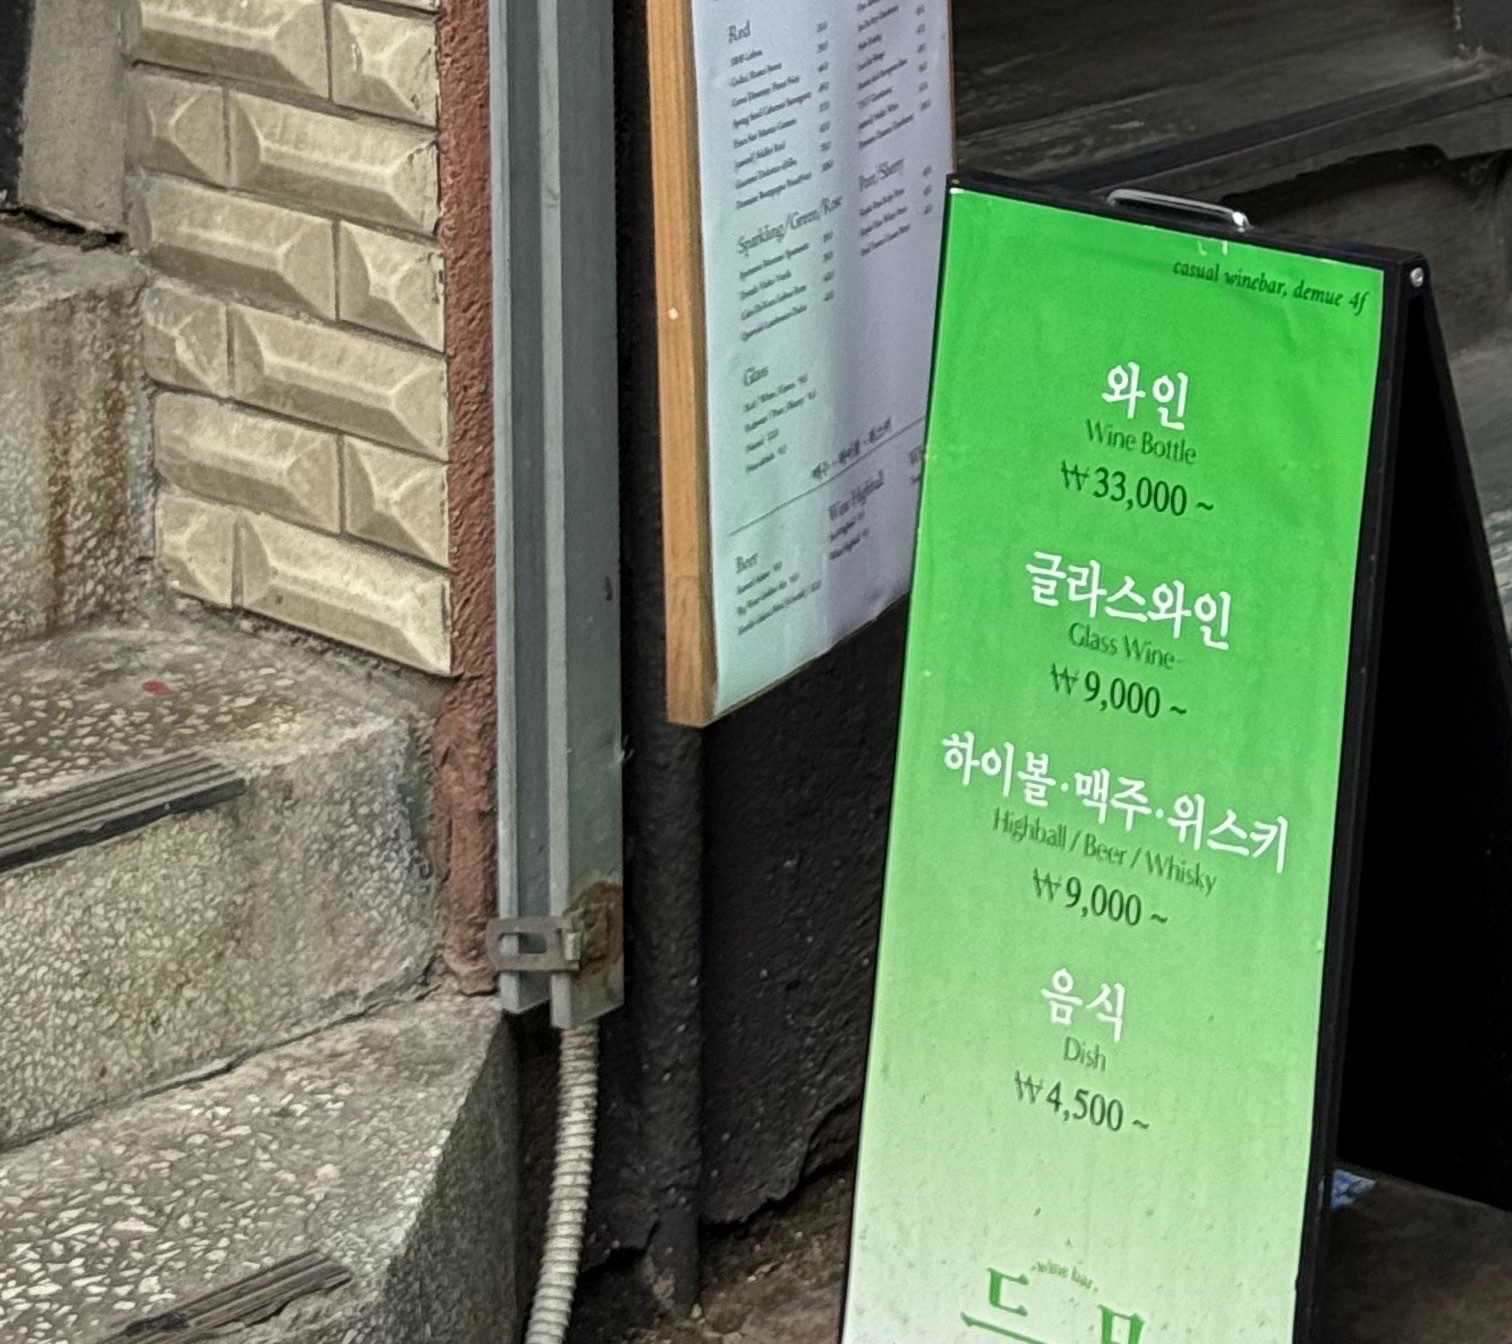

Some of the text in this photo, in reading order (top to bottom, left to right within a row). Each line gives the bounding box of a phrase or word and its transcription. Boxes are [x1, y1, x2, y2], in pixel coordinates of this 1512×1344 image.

[728, 19, 751, 44] Red
[1172, 261, 1370, 316] casual winebar, demue 4f
[1101, 361, 1190, 431] 와인
[1085, 419, 1197, 466] Wine Bottle
[1026, 550, 1232, 651] 글라스와인
[1067, 620, 1176, 671] Glass Wine
[992, 807, 1067, 849] Highball
[1083, 832, 1127, 864] Beer
[1145, 850, 1218, 897] Whisky
[1041, 967, 1127, 1042] 음식
[1063, 1035, 1107, 1072] Dish
